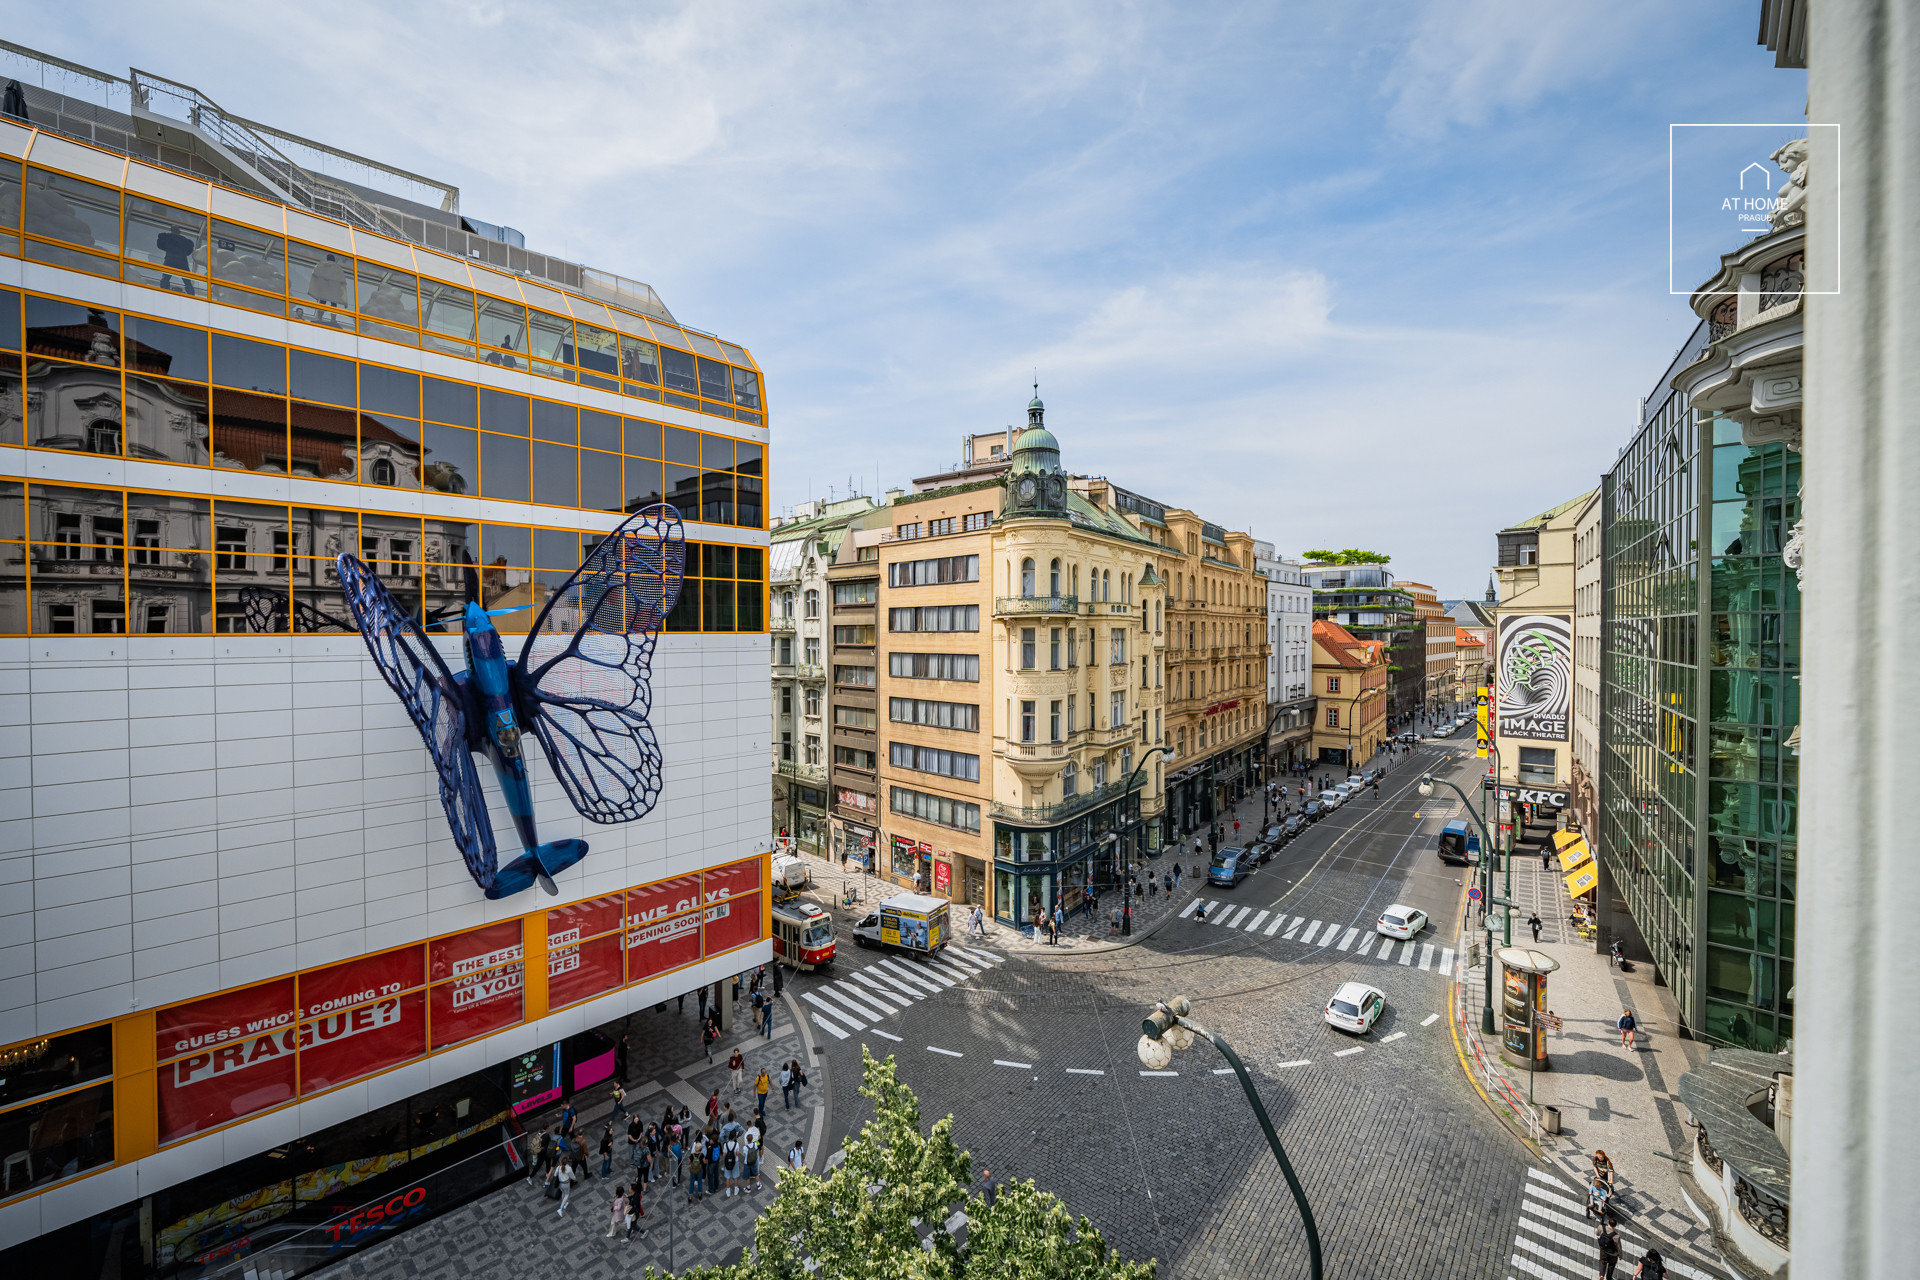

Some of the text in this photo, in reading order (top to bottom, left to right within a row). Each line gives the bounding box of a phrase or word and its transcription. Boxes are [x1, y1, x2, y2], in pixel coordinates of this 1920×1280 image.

[1503, 718, 1566, 733] IMAGE
[1503, 729, 1529, 737] BLACK
[1517, 789, 1566, 807] KFC
[620, 905, 669, 931] FIVE
[626, 925, 671, 945] OPENING
[674, 915, 701, 929] SOON
[453, 945, 579, 988] YOU'VE EV ATEN
[456, 931, 578, 973] THE BEST RGER
[456, 956, 577, 1004] IN YOU IFE!
[174, 982, 401, 1051] GUESS WHO'S COMING TO
[177, 998, 399, 1084] PRAGUE?
[325, 1187, 427, 1242] TESCO
[198, 1237, 251, 1265] TESCO
